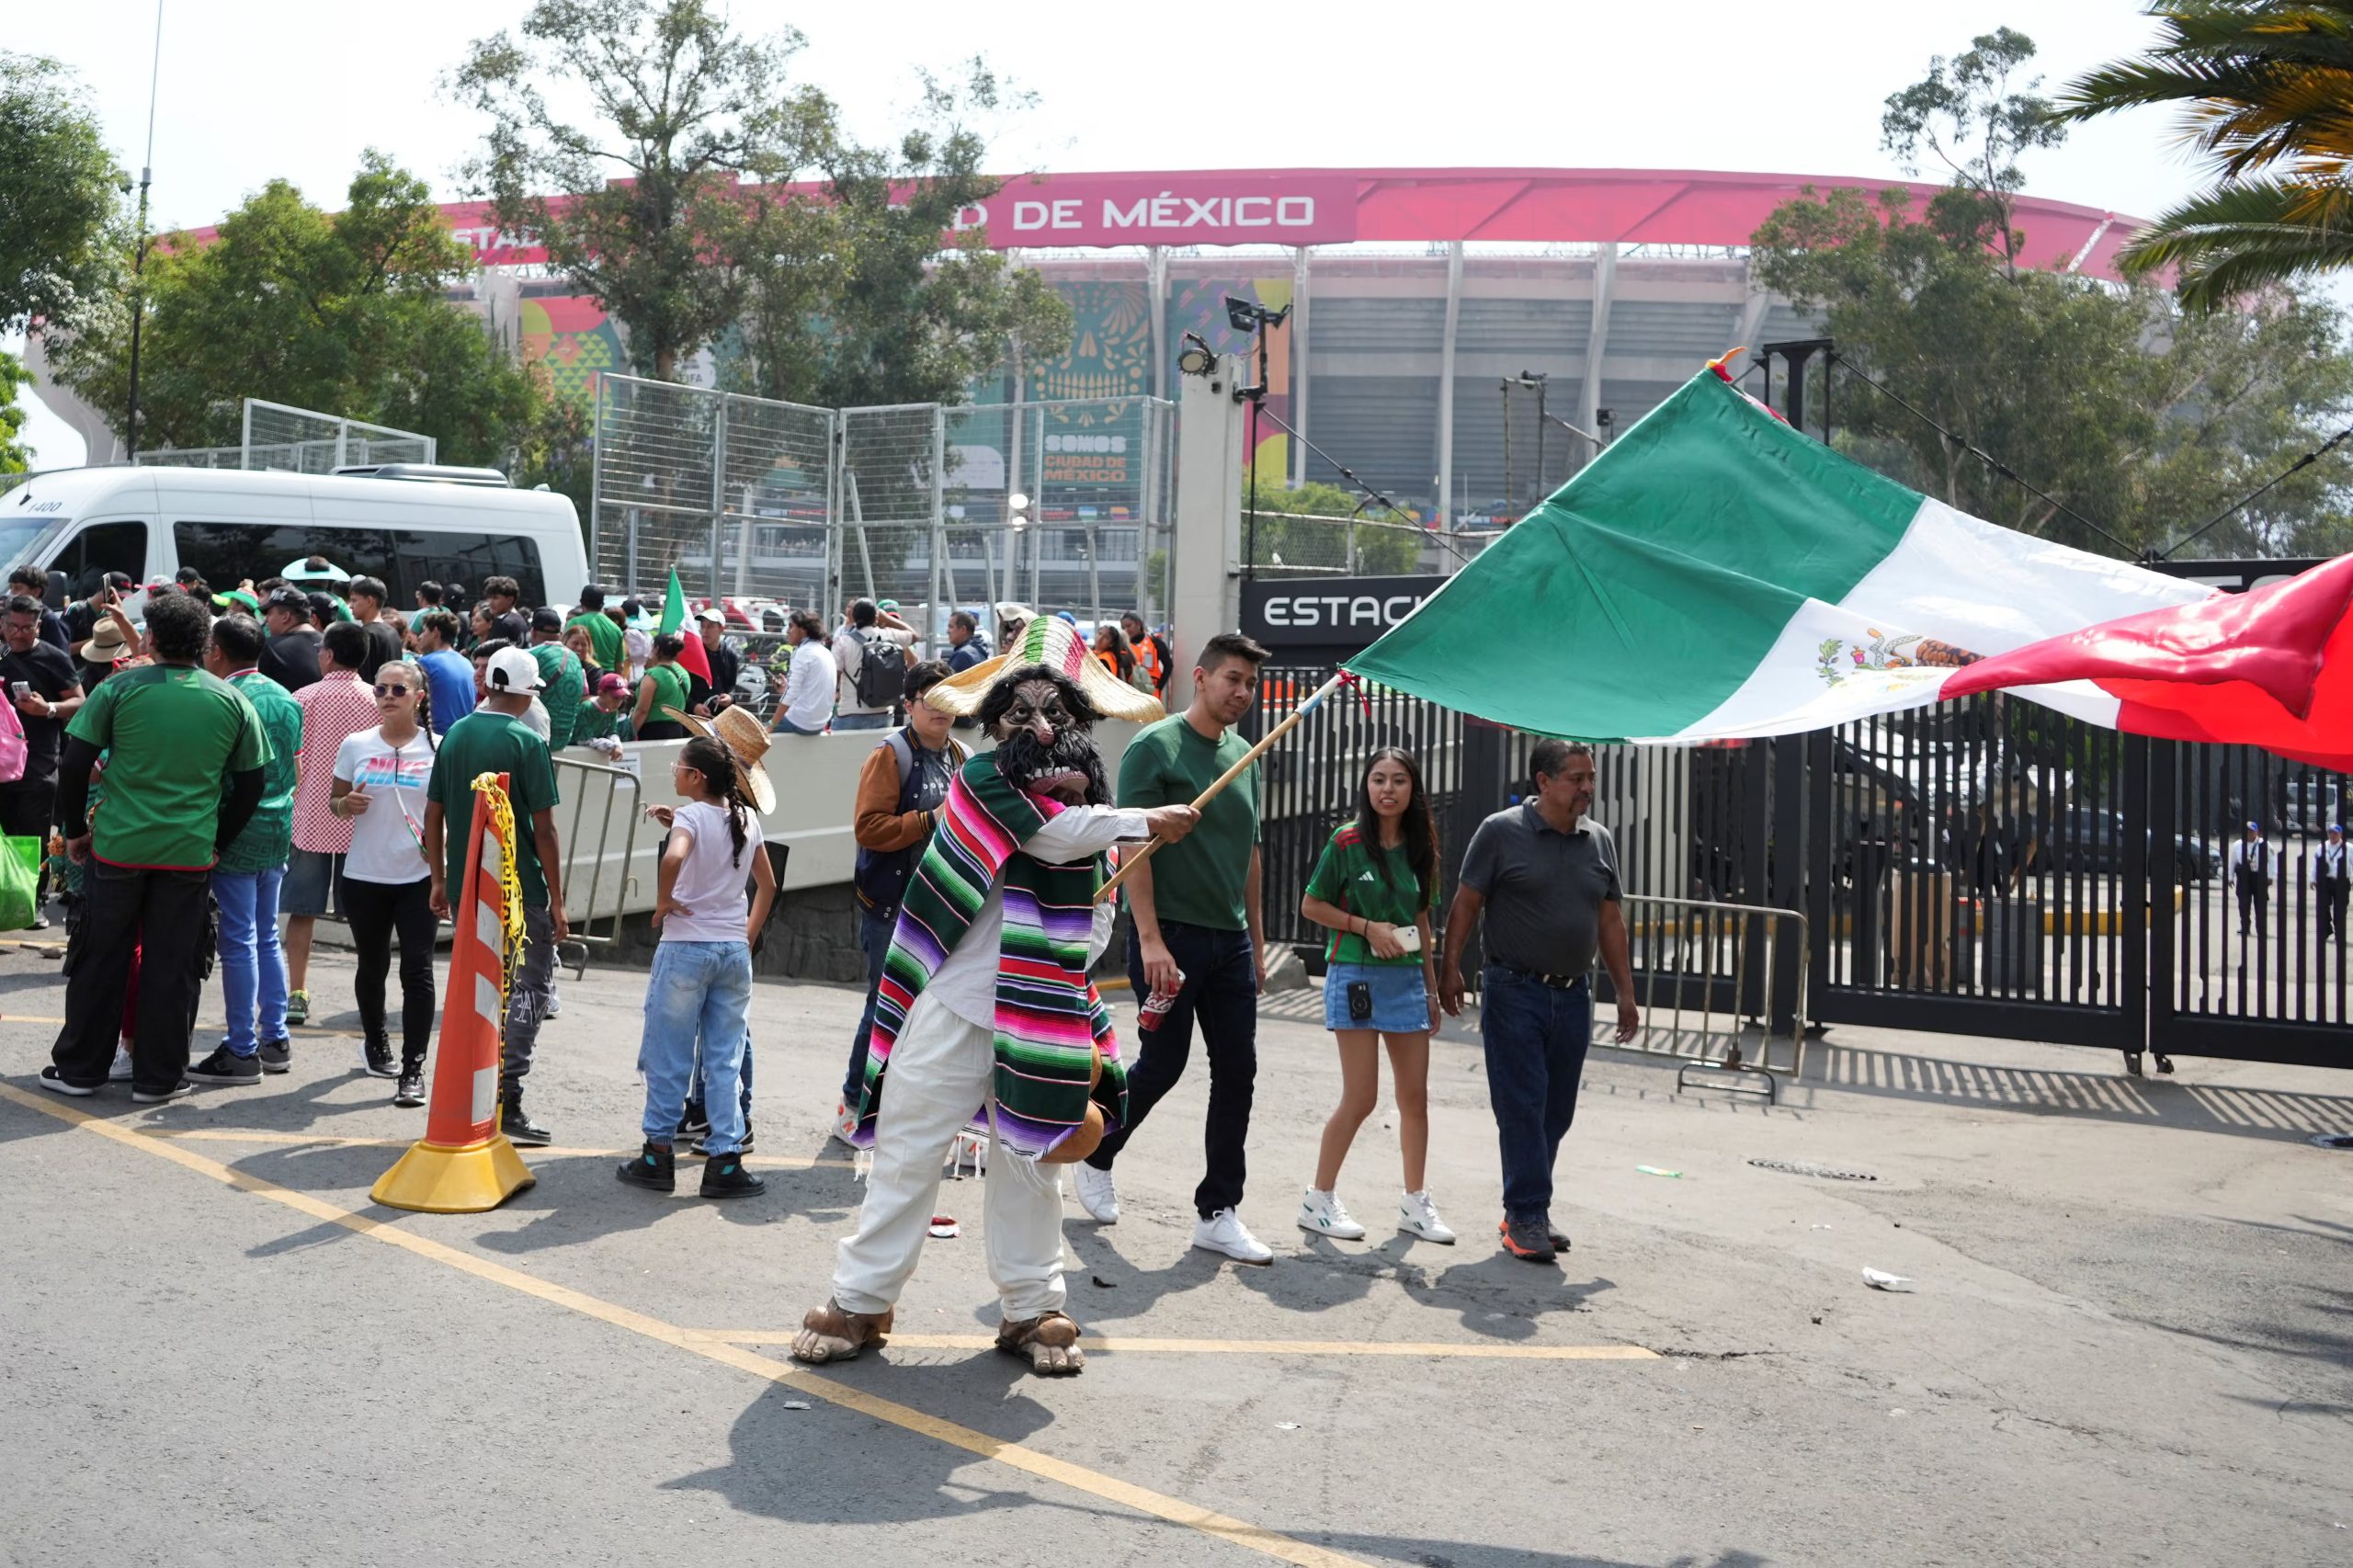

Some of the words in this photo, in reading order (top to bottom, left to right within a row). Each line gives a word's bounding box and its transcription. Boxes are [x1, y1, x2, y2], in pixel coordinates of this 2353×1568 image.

[1013, 199, 1083, 230] DE
[1103, 191, 1314, 228] MÉXICO
[1044, 435, 1126, 453] SOMOS
[1044, 456, 1103, 468] CIUDAD
[1106, 456, 1126, 468] DE
[1043, 468, 1126, 482] MÉXICO
[357, 757, 428, 787] NIKE
